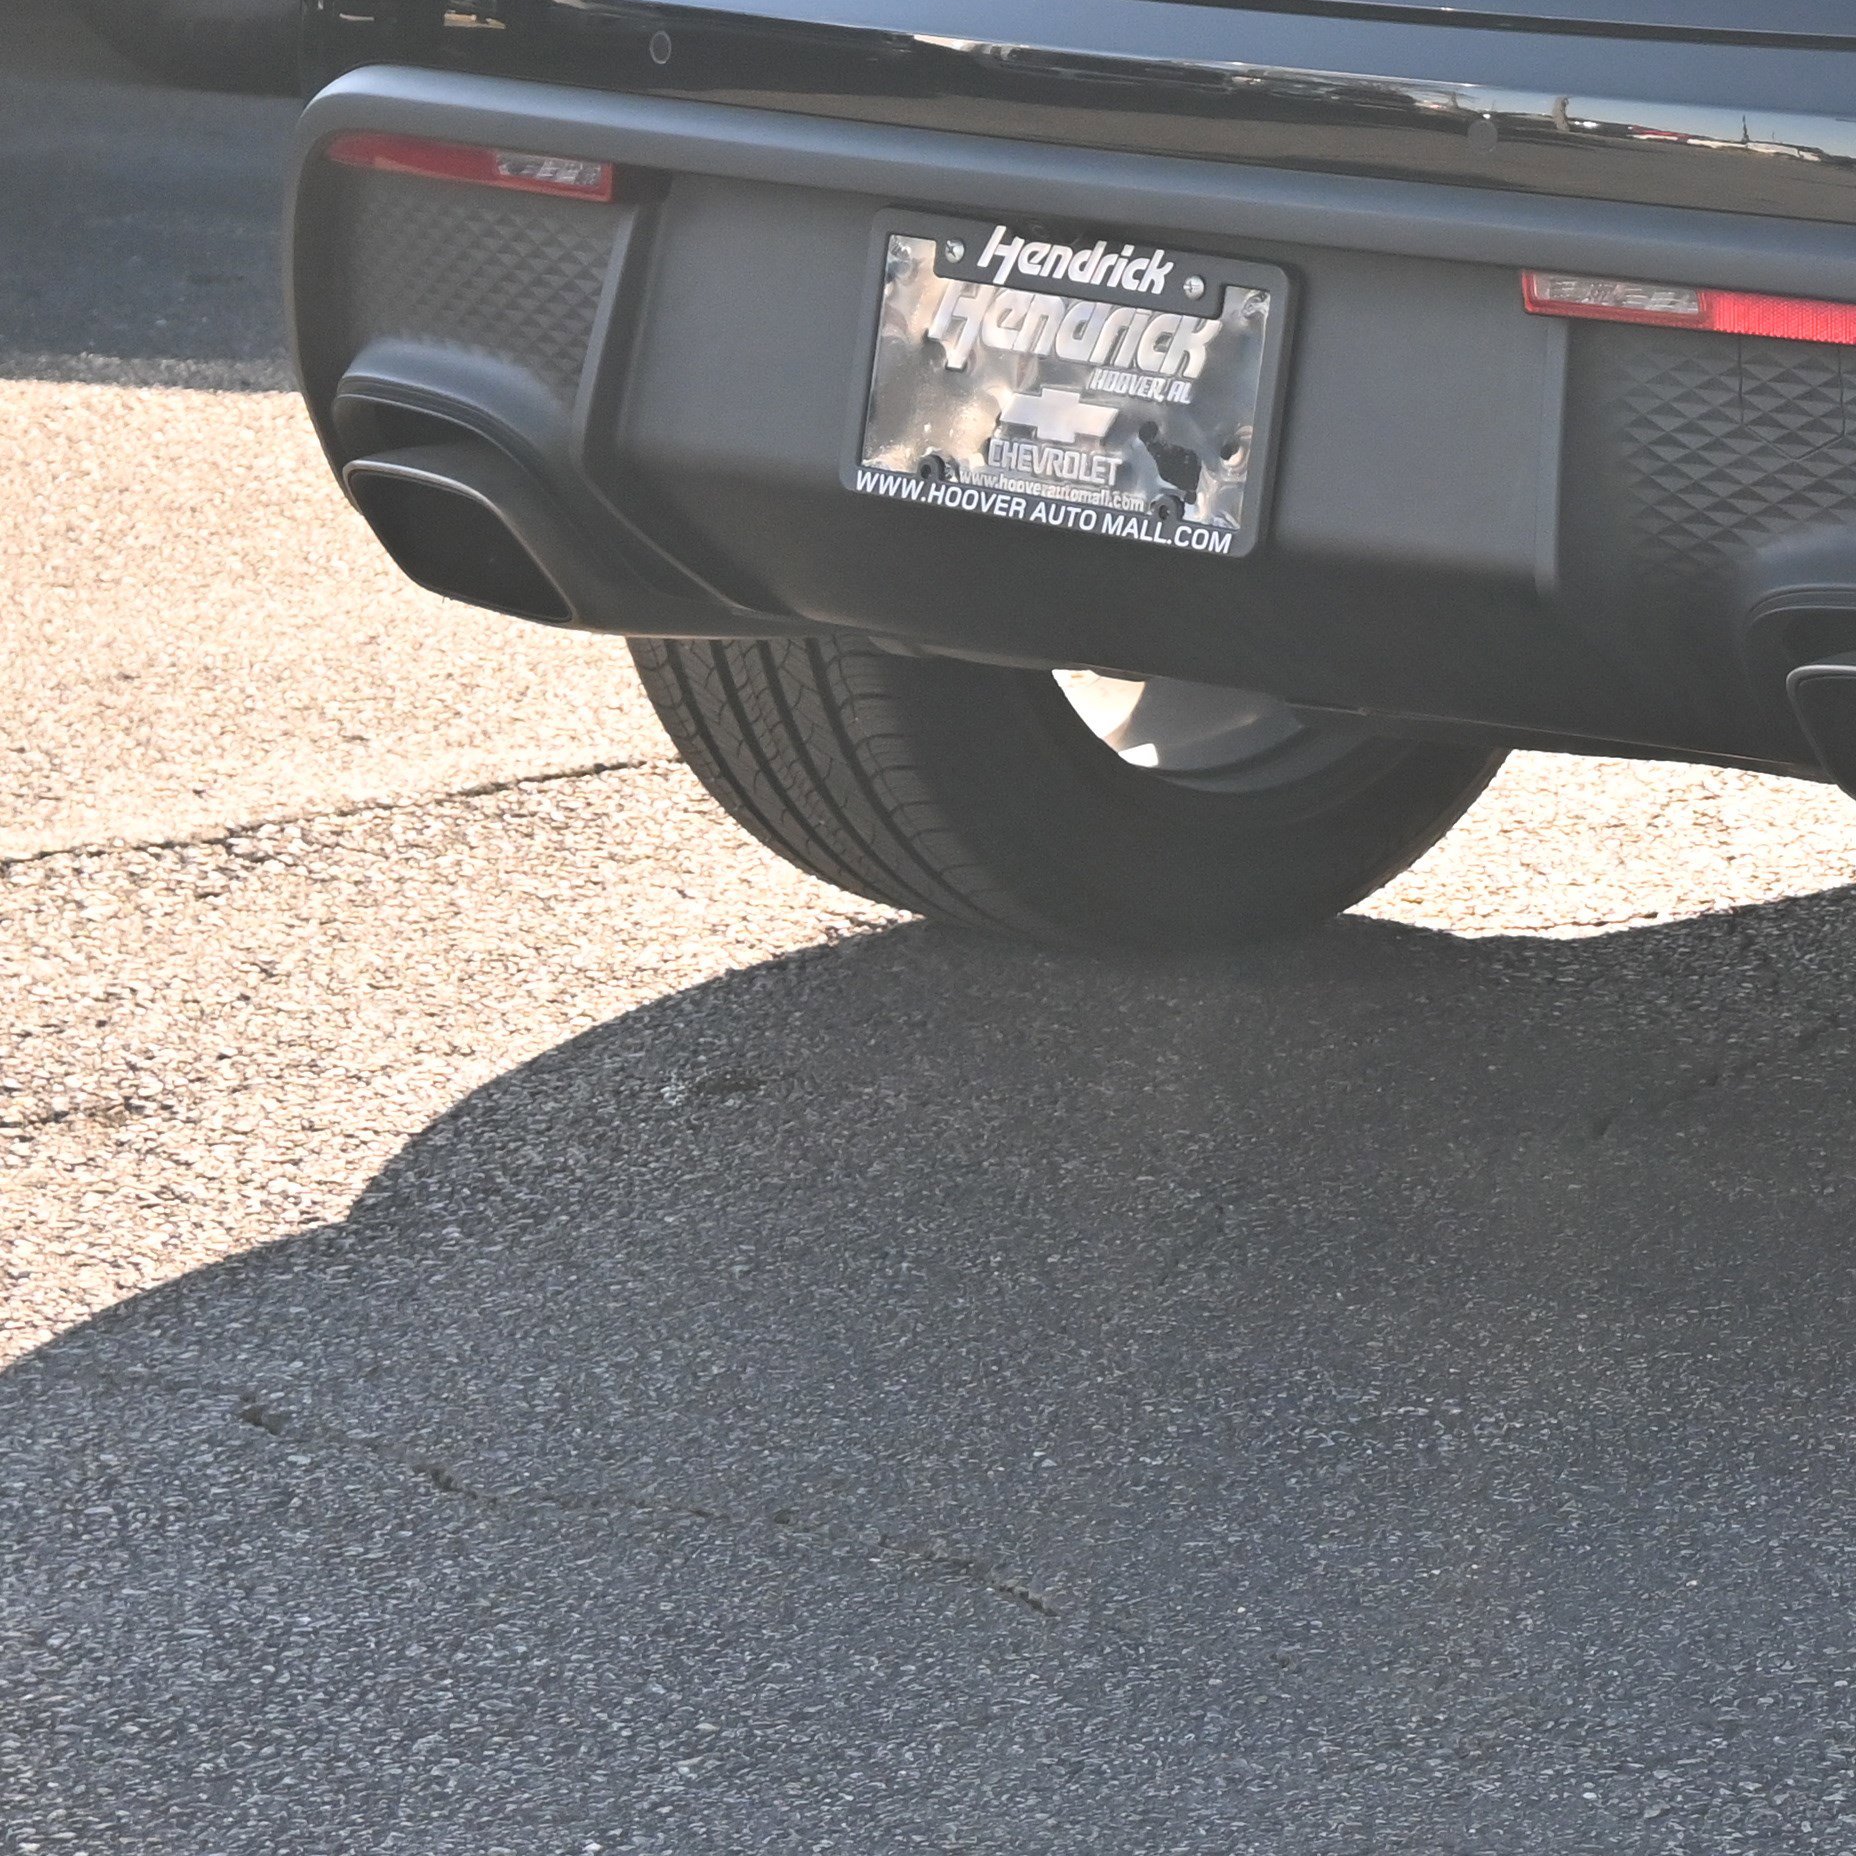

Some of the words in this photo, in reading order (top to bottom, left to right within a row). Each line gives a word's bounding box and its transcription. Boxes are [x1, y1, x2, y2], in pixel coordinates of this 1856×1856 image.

[976, 224, 1175, 295] Hendrick
[927, 279, 1222, 377] Hendrick
[1091, 367, 1165, 401] HOOVER,
[1167, 378, 1192, 405] AL
[959, 469, 1144, 513] www.hooverautomall.com
[987, 437, 1123, 486] CHEVROLET
[855, 469, 1027, 519] WWW.HOOVER
[1029, 500, 1098, 532] AUTO
[1100, 512, 1233, 555] MALL.COM
